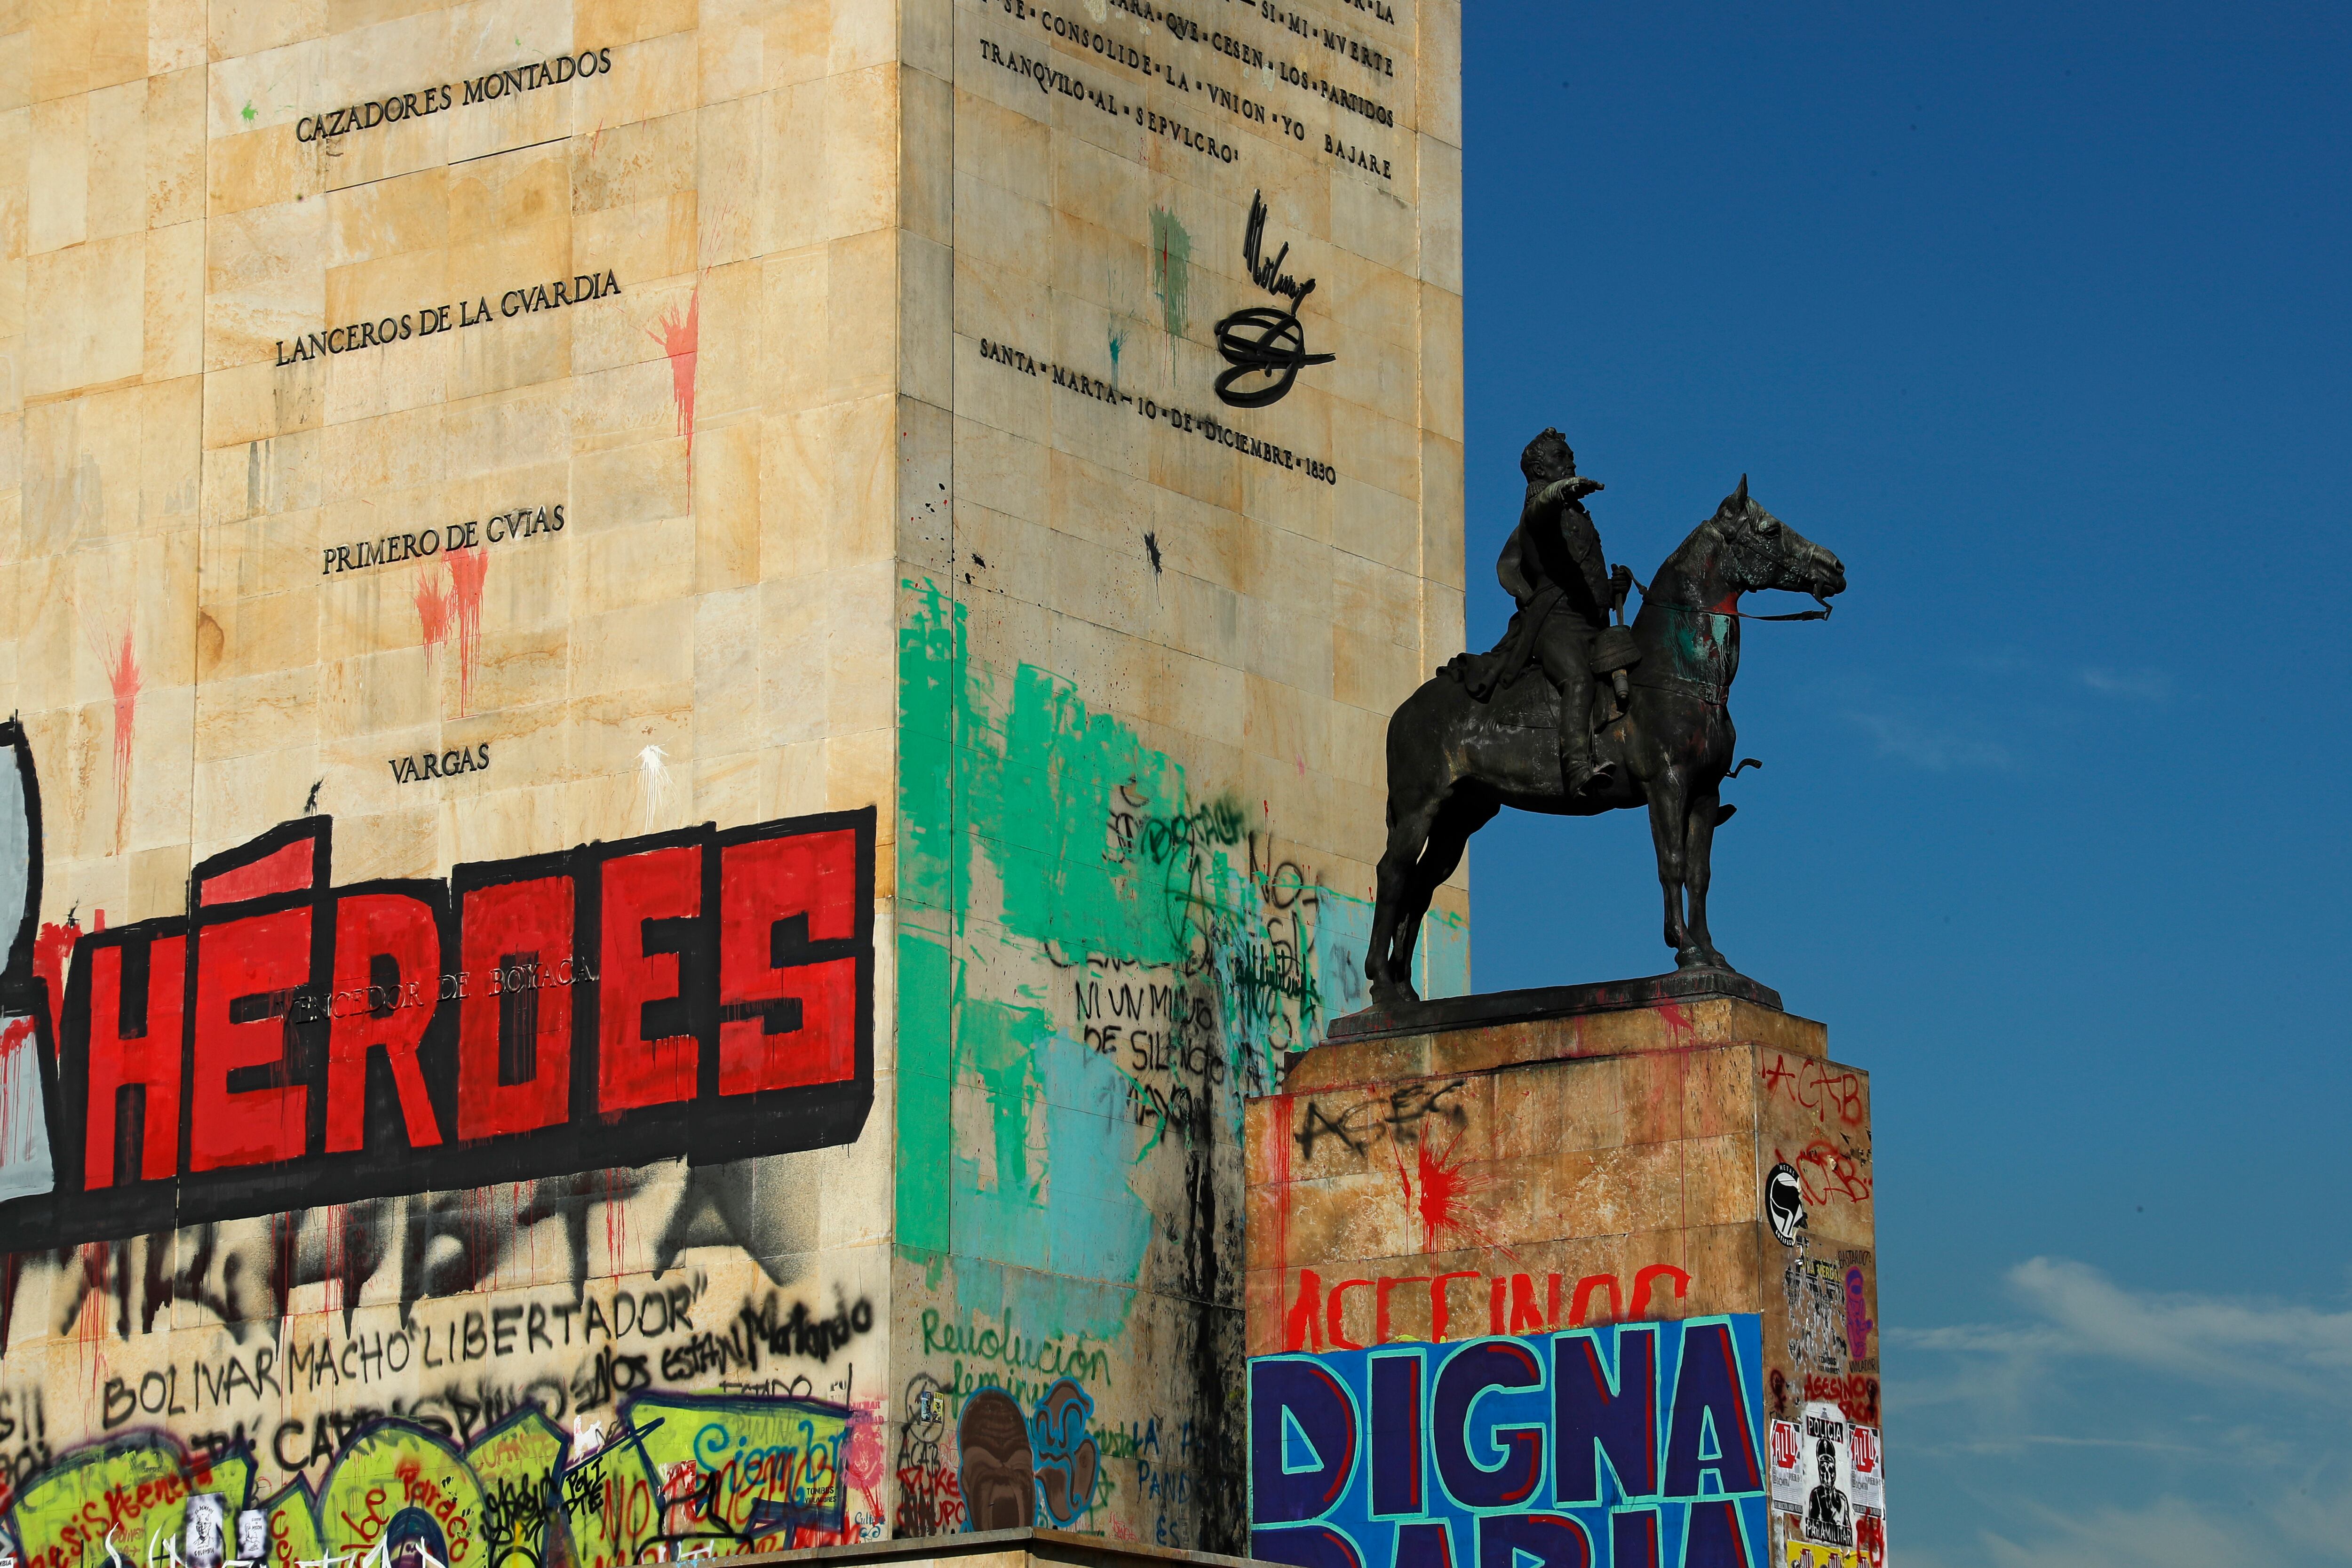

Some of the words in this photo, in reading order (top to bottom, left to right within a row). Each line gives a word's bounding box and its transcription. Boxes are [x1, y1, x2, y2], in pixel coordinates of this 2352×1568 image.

[1262, 0, 1276, 23] SI
[1288, 13, 1308, 38] MI
[1323, 28, 1393, 77] MVERTE
[1376, 0, 1394, 25] LA
[296, 85, 451, 142] CAZADORES
[463, 48, 612, 106] MONTADOS
[980, 39, 1084, 101] TRANQVILO
[1095, 89, 1119, 116] AL
[1004, 0, 1025, 20] SE
[1041, 11, 1152, 76] CONSOLIDE
[1166, 64, 1189, 93] LA
[1208, 83, 1265, 124] VNION
[1282, 115, 1305, 141] YO
[1324, 135, 1391, 180] BAJARE
[1110, 0, 1155, 22] ARA
[1166, 11, 1199, 42] QVE
[1212, 32, 1263, 69] CESEN
[1280, 62, 1308, 90] LOS
[1319, 79, 1393, 128] PARTIDOS
[276, 314, 411, 366] LANCEROS
[419, 305, 452, 336] DE
[460, 296, 493, 327] LA
[501, 269, 621, 318] GVARDIA
[979, 338, 1037, 376] SANTA
[1051, 365, 1117, 405] MARTA
[1171, 408, 1192, 433] DE
[1204, 420, 1293, 470] DICIEMBRE
[1306, 458, 1336, 486] 1830
[323, 529, 439, 574] PRIMERO
[446, 521, 479, 551] DE
[486, 504, 565, 543] GVIAS
[389, 743, 490, 785] VARGAS
[78, 807, 875, 1197] HÉROES
[276, 981, 424, 1025] VENCEDOR
[437, 972, 470, 1003] DE
[1076, 981, 1100, 1021] NI
[1108, 984, 1144, 1020] UN
[1149, 984, 1212, 1030] MIUTO
[1131, 1031, 1225, 1085] SILNCIO
[1780, 1165, 1795, 1177] METAL
[103, 1348, 281, 1429] BOLIVAR
[289, 1334, 410, 1394] MACHO
[1247, 1316, 1765, 1528] DIGNA
[1807, 1416, 1843, 1443] POLICIA
[600, 1474, 650, 1541] NO
